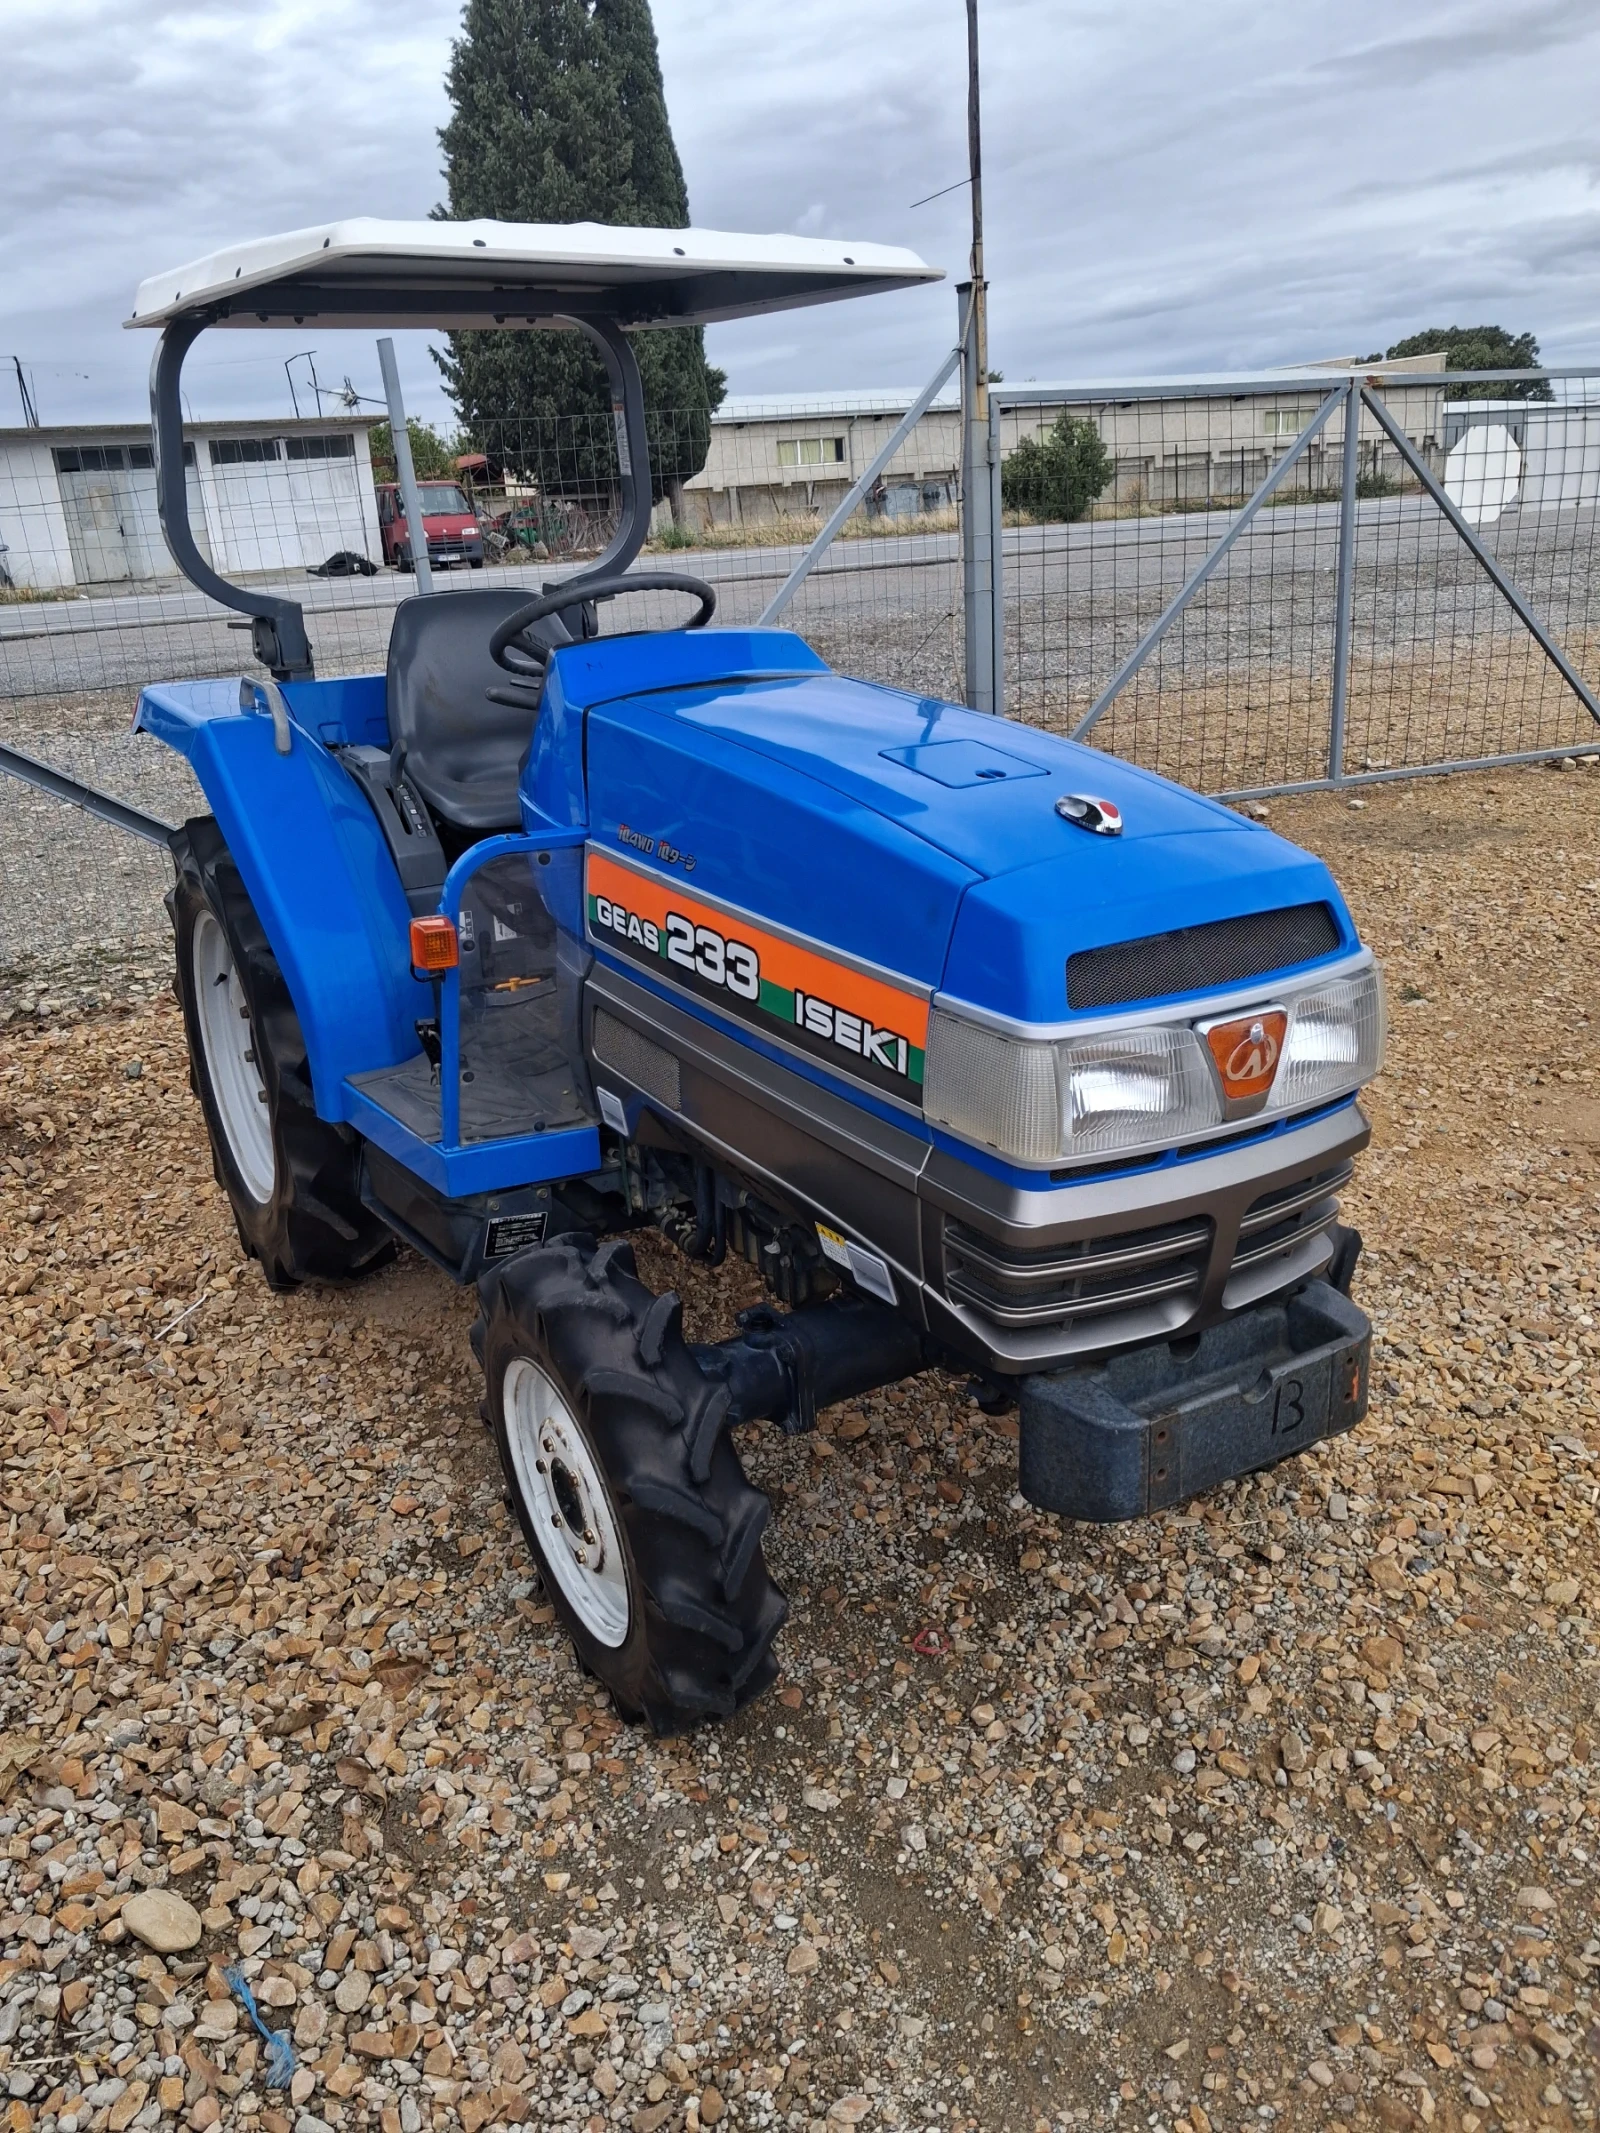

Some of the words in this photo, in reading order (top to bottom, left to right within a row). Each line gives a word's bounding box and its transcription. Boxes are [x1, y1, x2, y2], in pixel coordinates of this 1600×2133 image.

[596, 896, 660, 953] GEAS
[666, 913, 760, 1001] 233
[794, 991, 908, 1076] ISEKI
